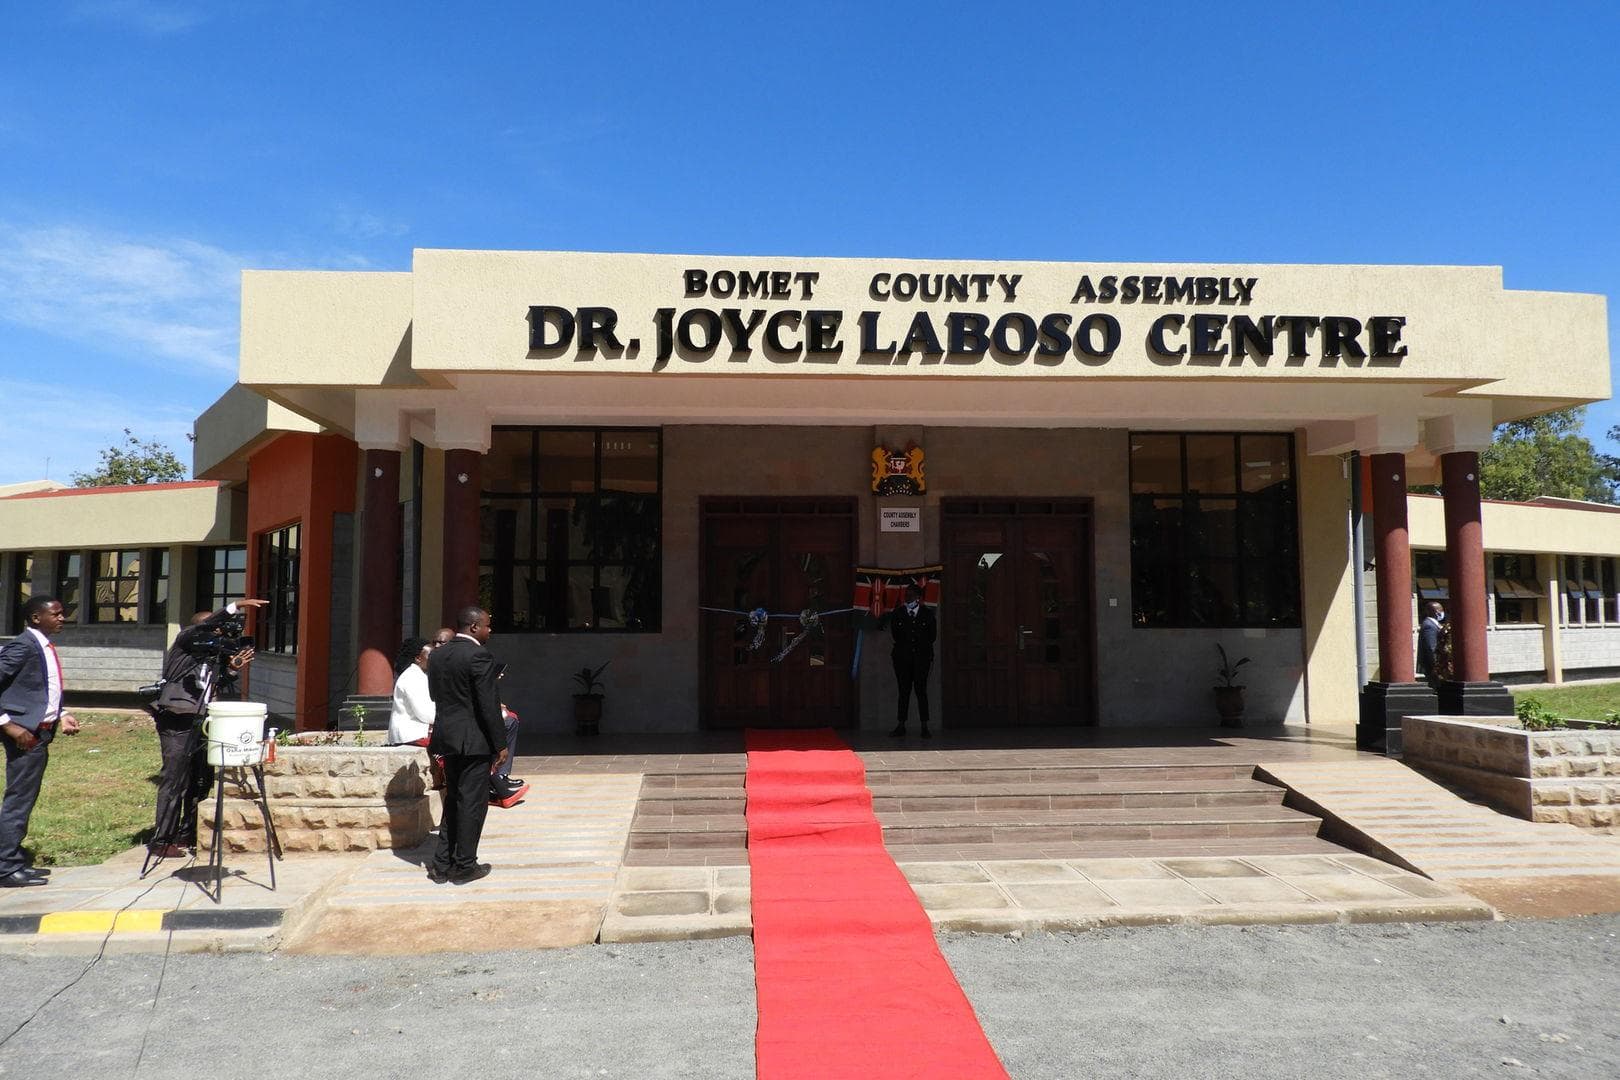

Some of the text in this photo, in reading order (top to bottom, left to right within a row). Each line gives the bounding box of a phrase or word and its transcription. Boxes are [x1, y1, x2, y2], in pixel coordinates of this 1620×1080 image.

[684, 270, 1258, 306] BOMET COUNTY ASSEMBLY
[526, 306, 1408, 372] DR. JOYCE LABOSO CENTRE
[883, 511, 898, 519] COUNTY
